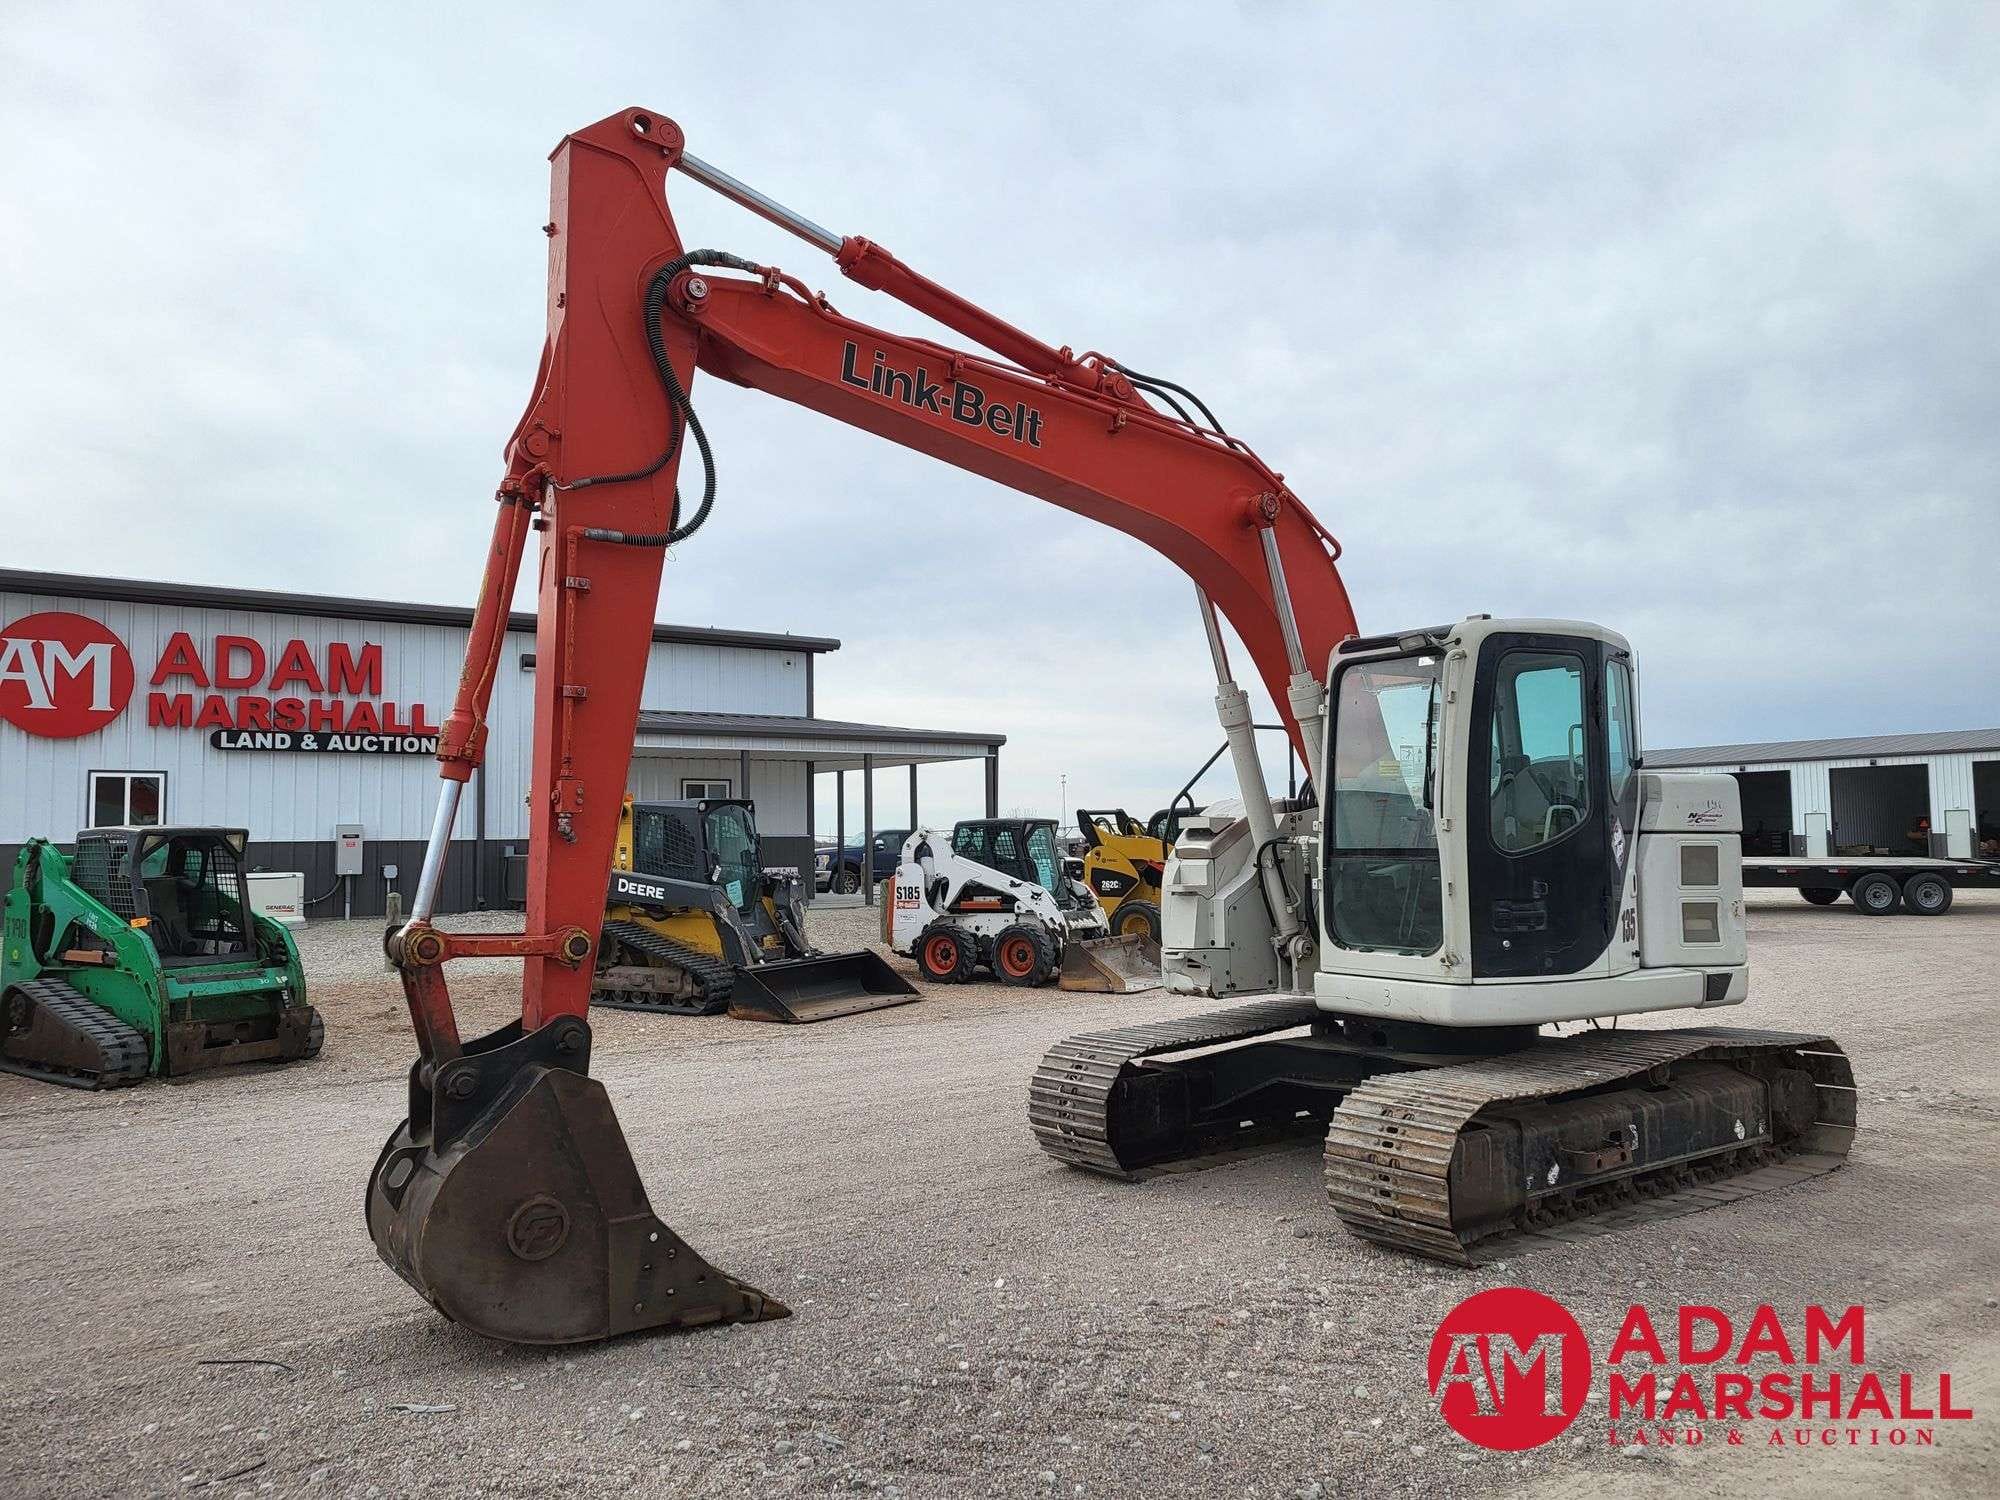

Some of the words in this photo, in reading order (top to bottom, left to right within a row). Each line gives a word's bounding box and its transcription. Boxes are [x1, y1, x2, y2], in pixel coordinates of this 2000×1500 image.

[841, 340, 1043, 448] Link-Belt
[0, 637, 116, 711] AM
[150, 632, 382, 695] ADAM
[148, 693, 440, 735] MARSHALL
[220, 732, 291, 750] LAND
[301, 735, 319, 751] &
[328, 737, 436, 753] AUCTION
[617, 878, 665, 899] DEERE
[896, 886, 920, 900] S185
[1622, 907, 1636, 943] 135
